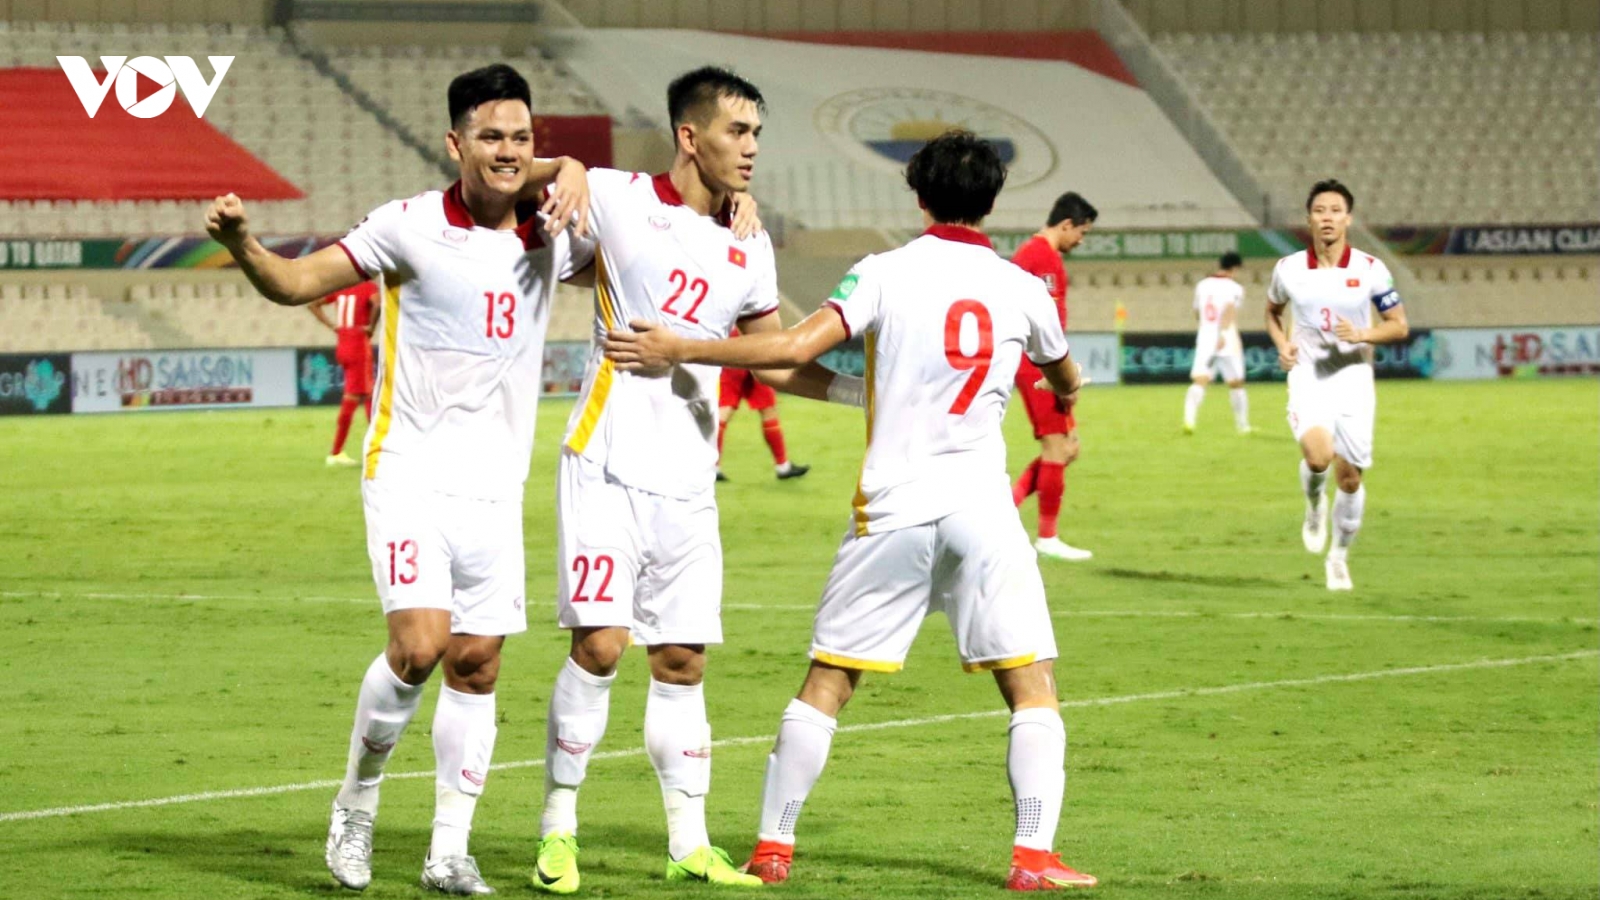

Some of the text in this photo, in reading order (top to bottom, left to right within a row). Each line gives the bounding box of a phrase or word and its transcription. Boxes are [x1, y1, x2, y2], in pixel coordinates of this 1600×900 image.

[337, 295, 356, 327] 11
[484, 291, 516, 339] 13
[661, 268, 709, 324] 22
[1205, 296, 1217, 322] 6
[1320, 308, 1332, 332] 3
[158, 355, 253, 388] SAISON
[943, 299, 994, 415] 9
[387, 540, 419, 586] 13
[571, 555, 615, 602] 22
